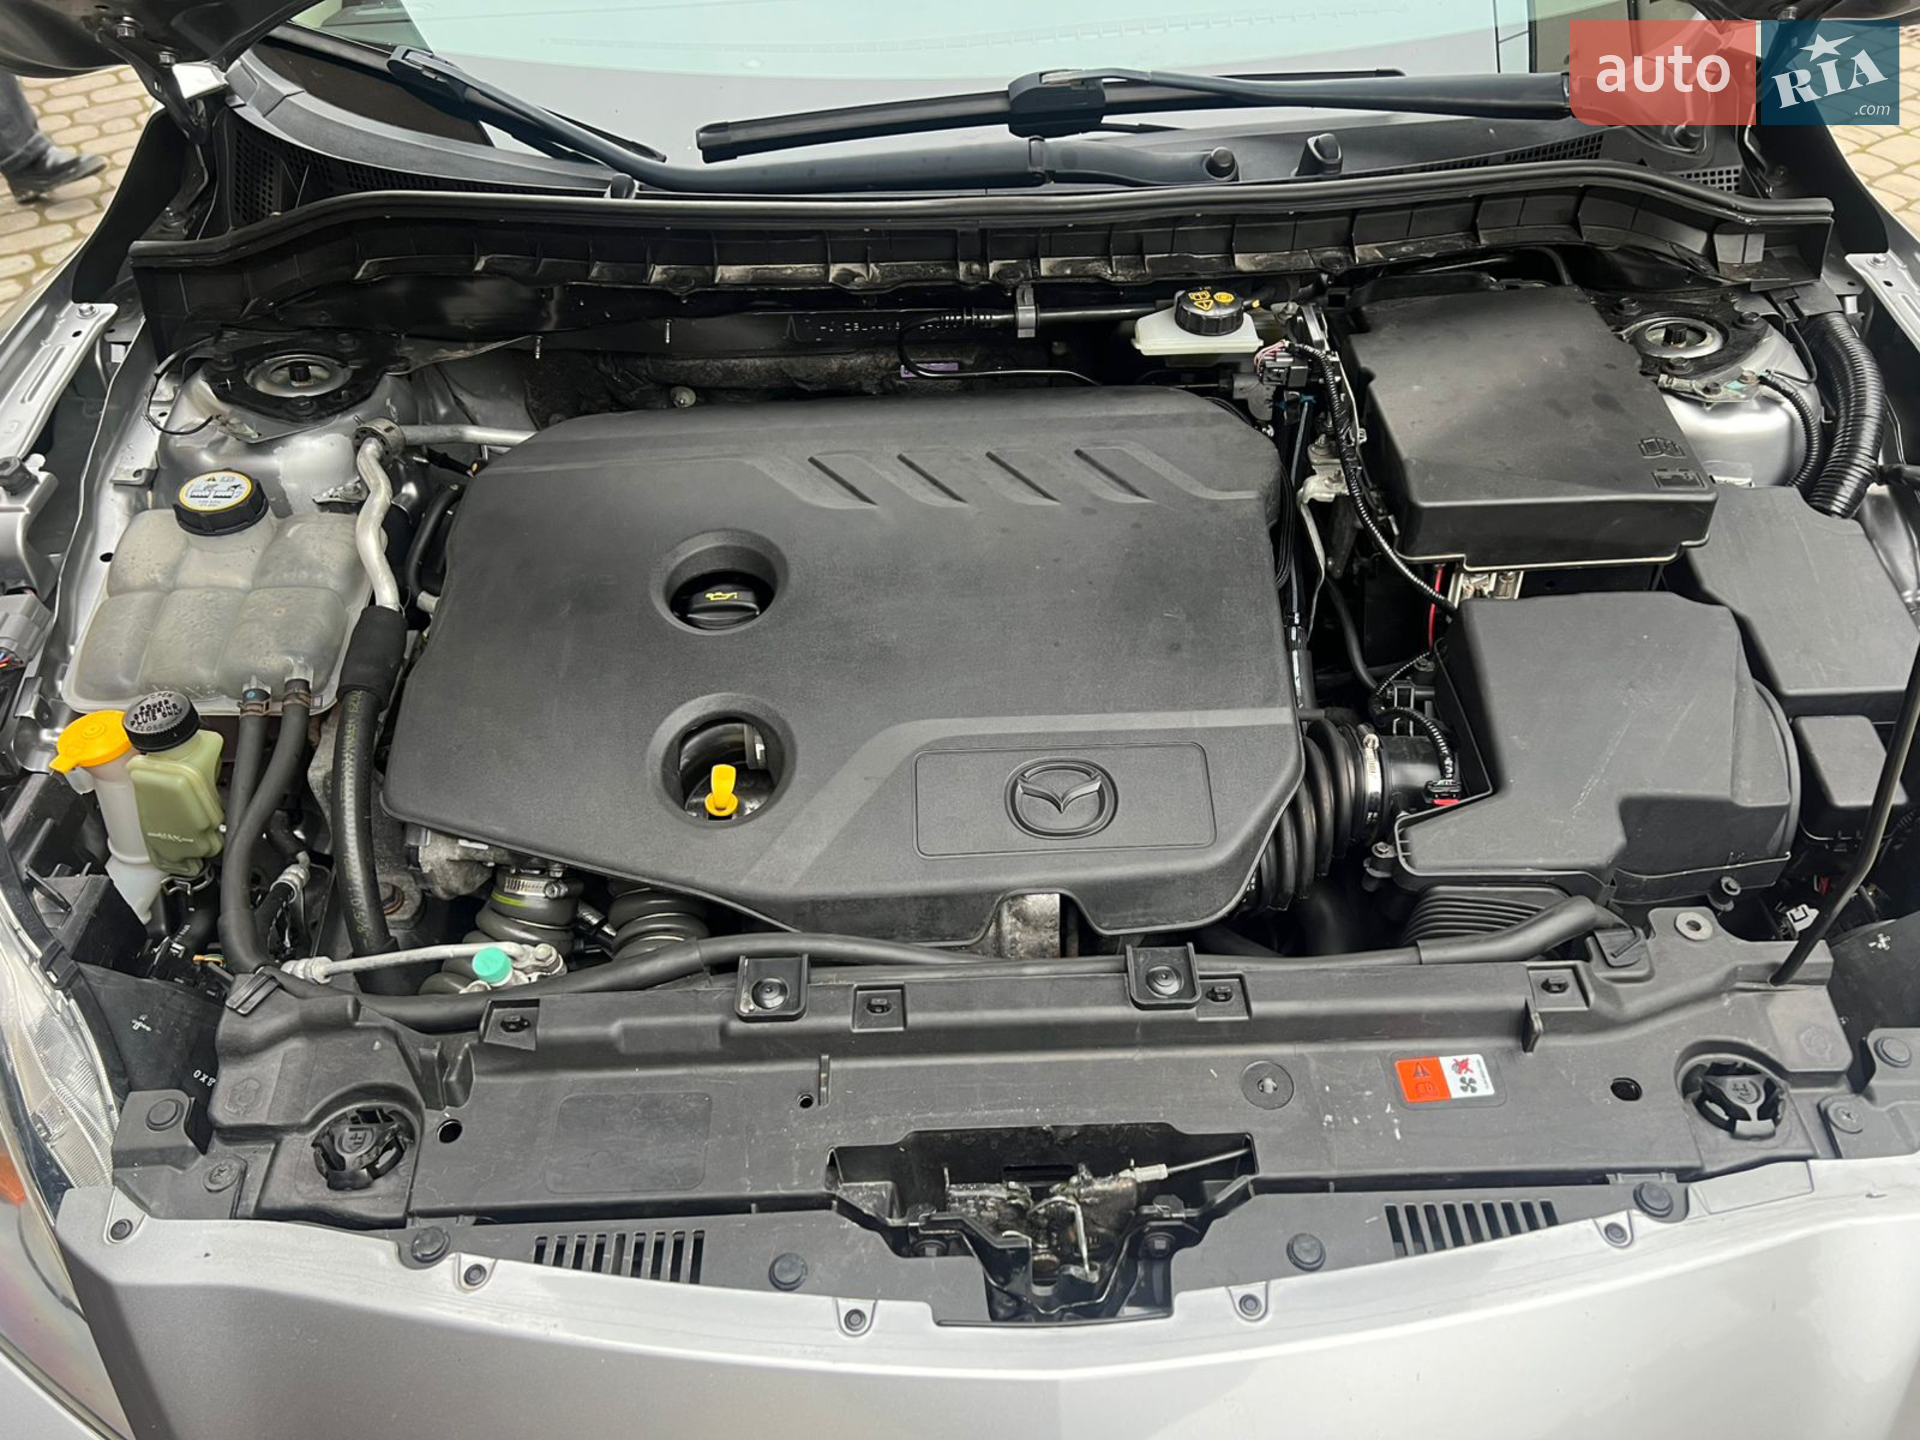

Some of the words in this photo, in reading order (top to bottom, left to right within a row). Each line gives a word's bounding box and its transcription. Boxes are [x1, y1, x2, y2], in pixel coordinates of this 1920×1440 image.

[139, 699, 169, 711] POWER
[130, 714, 158, 727] FLUID
[162, 708, 183, 718] ONLY
